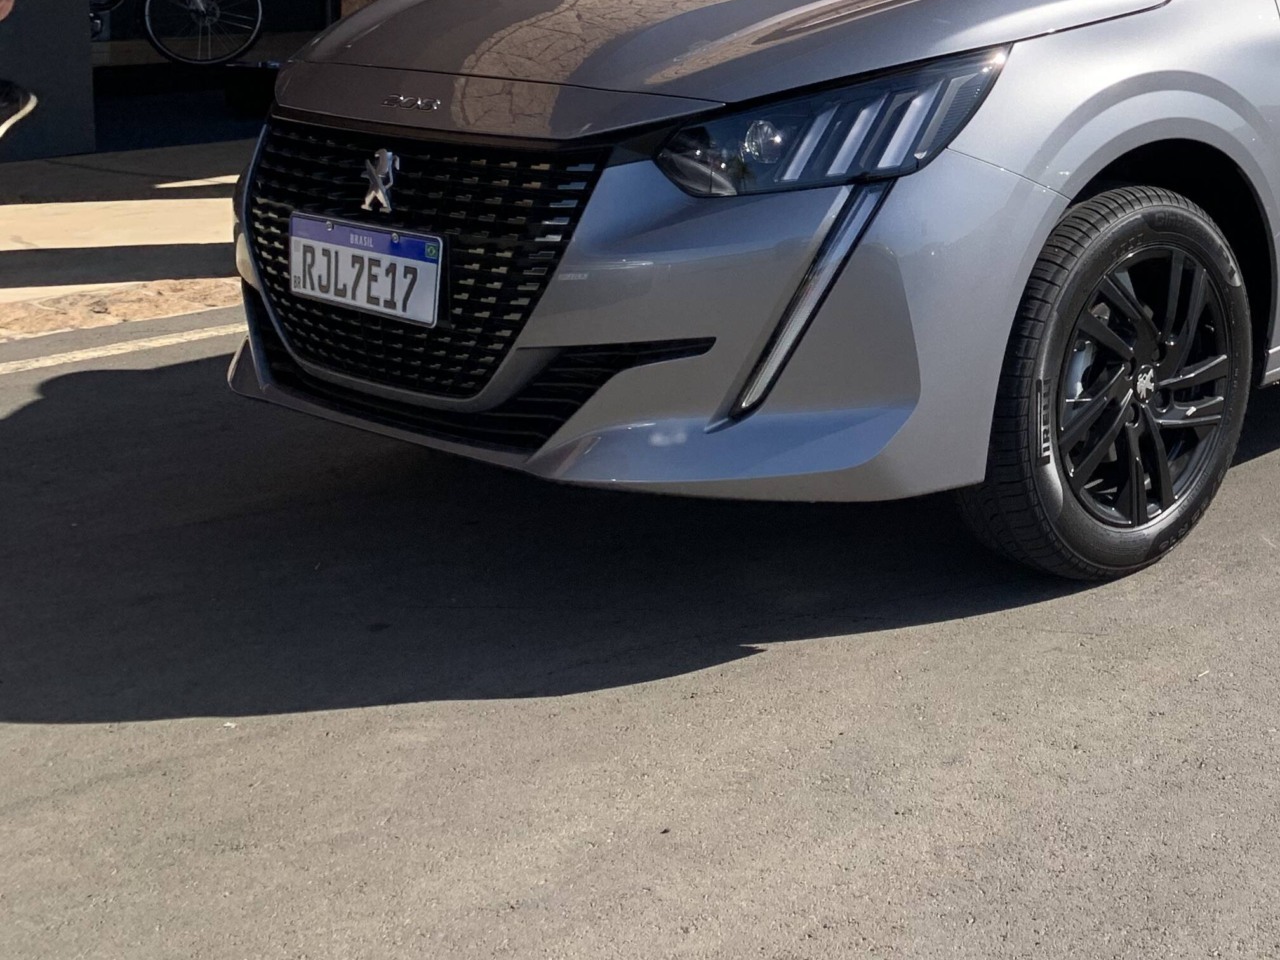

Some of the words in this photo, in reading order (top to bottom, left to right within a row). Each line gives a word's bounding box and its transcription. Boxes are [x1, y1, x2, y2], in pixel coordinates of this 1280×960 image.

[349, 233, 374, 248] BRASIL
[293, 275, 301, 289] BR
[302, 244, 418, 313] RJL7E17
[1035, 378, 1052, 467] PIRELLI
